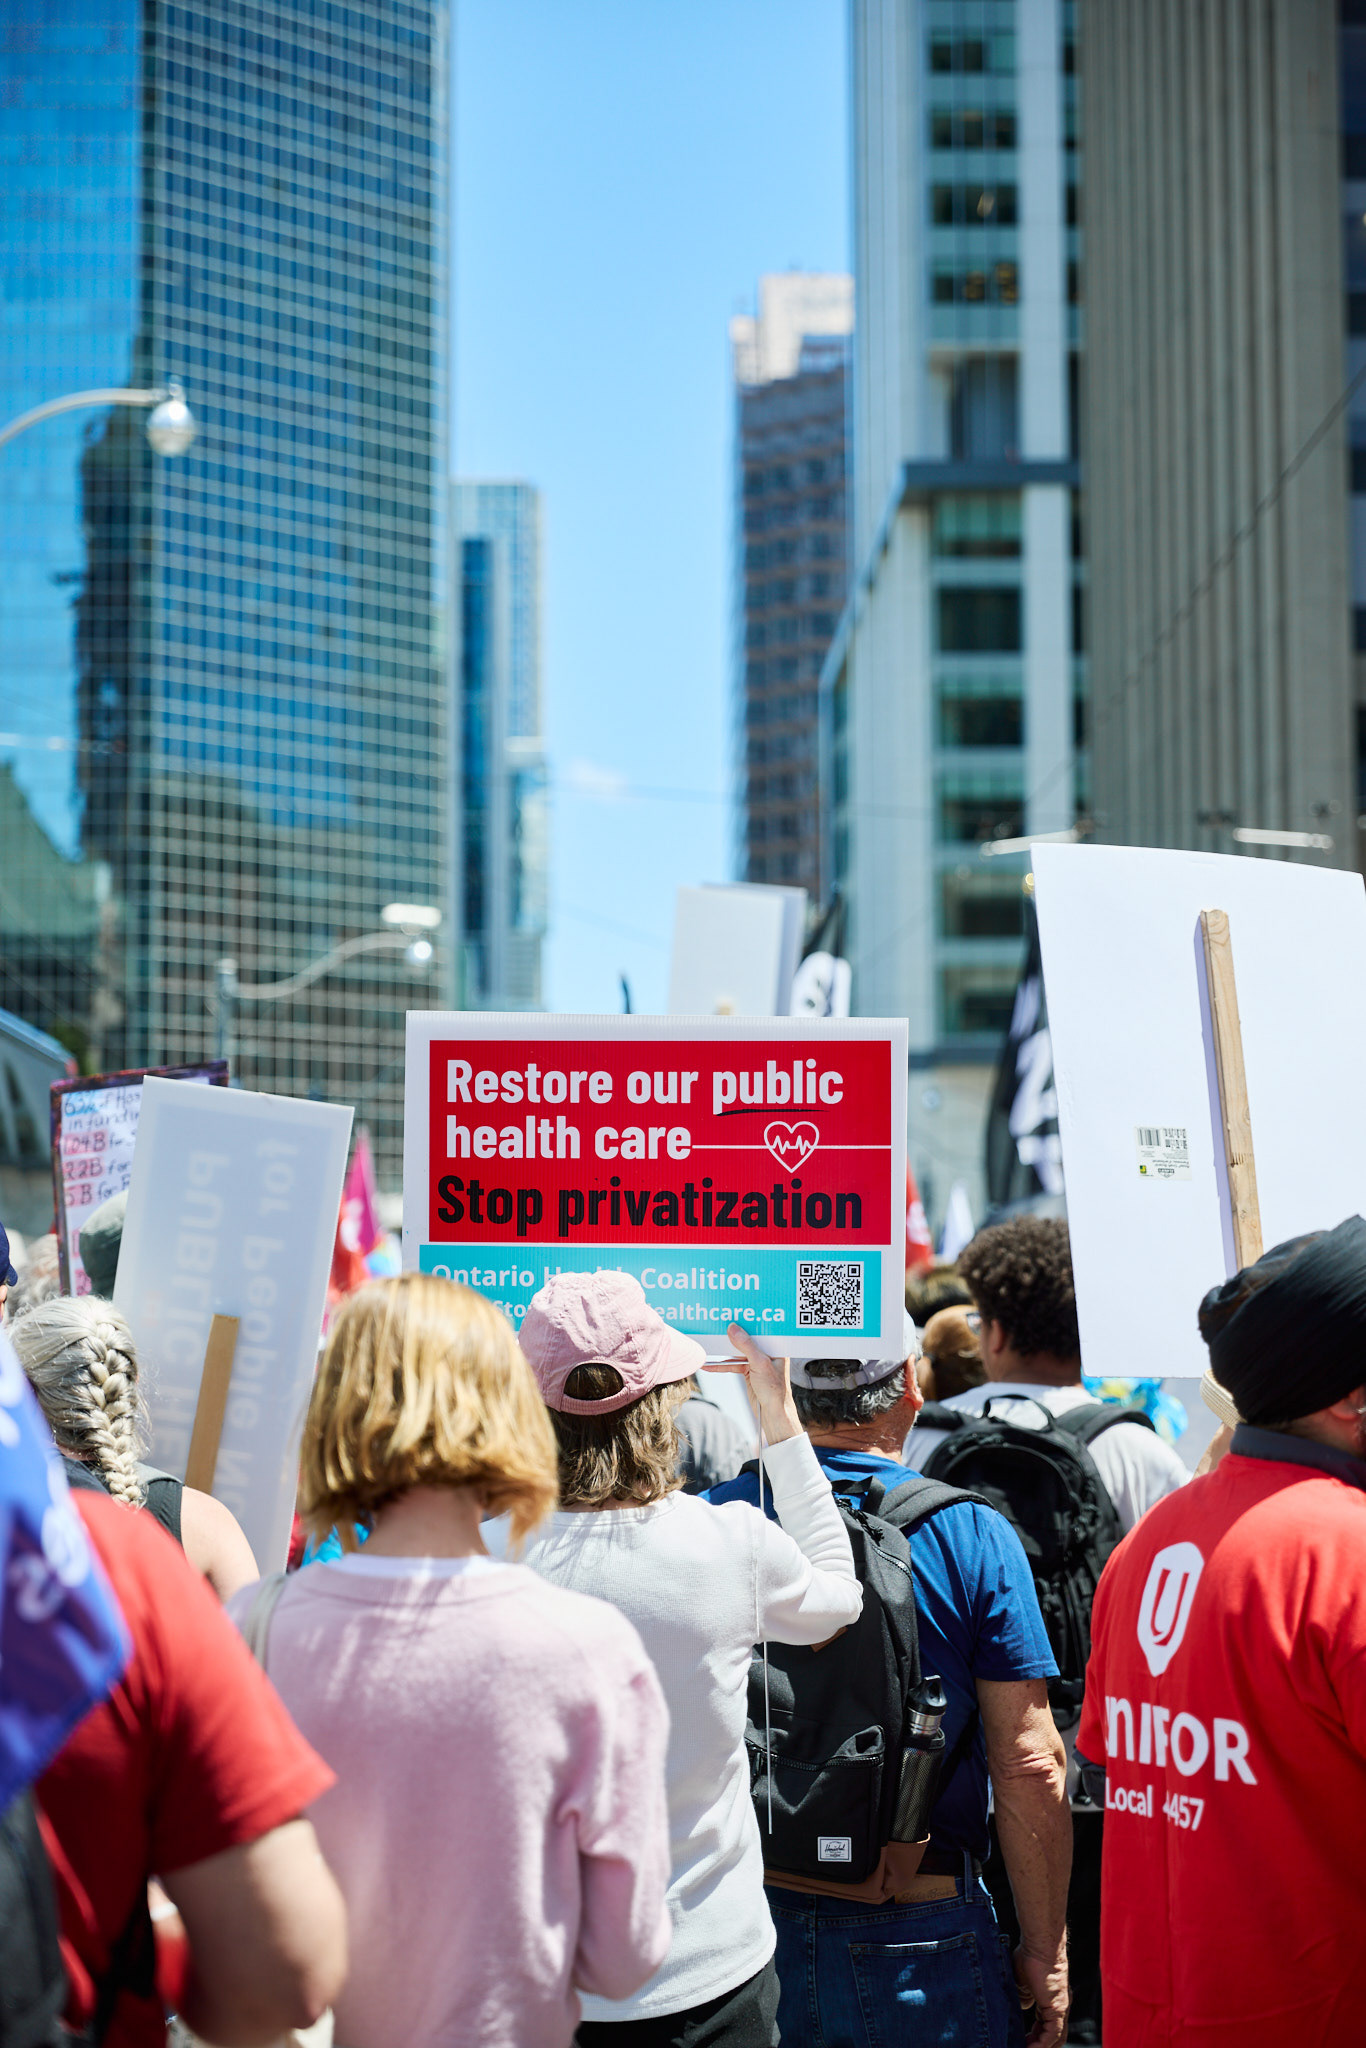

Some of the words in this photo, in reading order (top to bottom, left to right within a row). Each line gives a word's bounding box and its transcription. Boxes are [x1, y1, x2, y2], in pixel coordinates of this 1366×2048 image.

[447, 1059, 613, 1104] Restore
[626, 1070, 699, 1104] our
[712, 1058, 844, 1115] public
[446, 1114, 580, 1159] health
[595, 1126, 691, 1160] care
[437, 1175, 543, 1237] Stop
[558, 1176, 862, 1237] privatization
[431, 1264, 535, 1287] Ontario
[640, 1267, 760, 1291] Coalition
[655, 1302, 785, 1322] ealthcare.ca
[1105, 1776, 1153, 1819] Local
